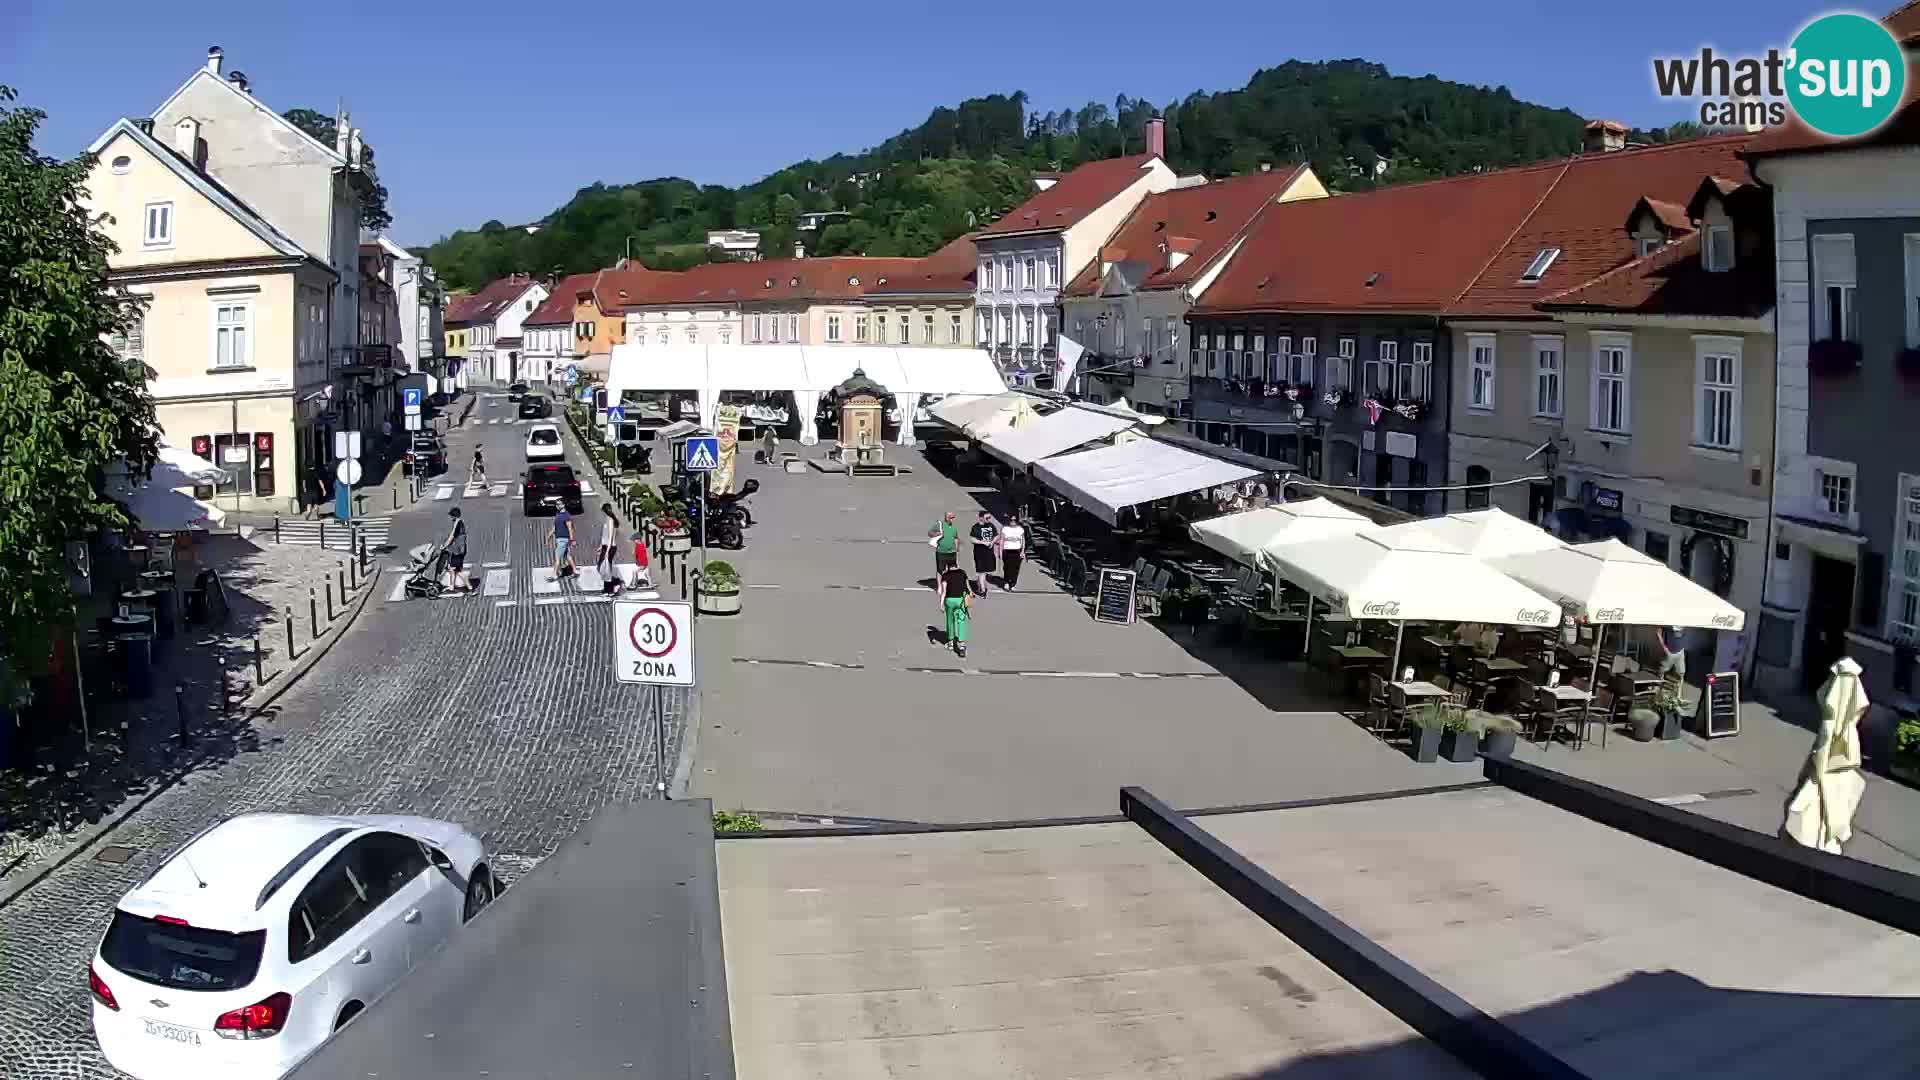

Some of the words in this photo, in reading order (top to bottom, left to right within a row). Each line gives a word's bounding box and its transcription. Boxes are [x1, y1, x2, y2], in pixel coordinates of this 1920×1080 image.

[408, 391, 417, 404] P
[642, 623, 665, 645] 30
[633, 660, 677, 678] ZONA
